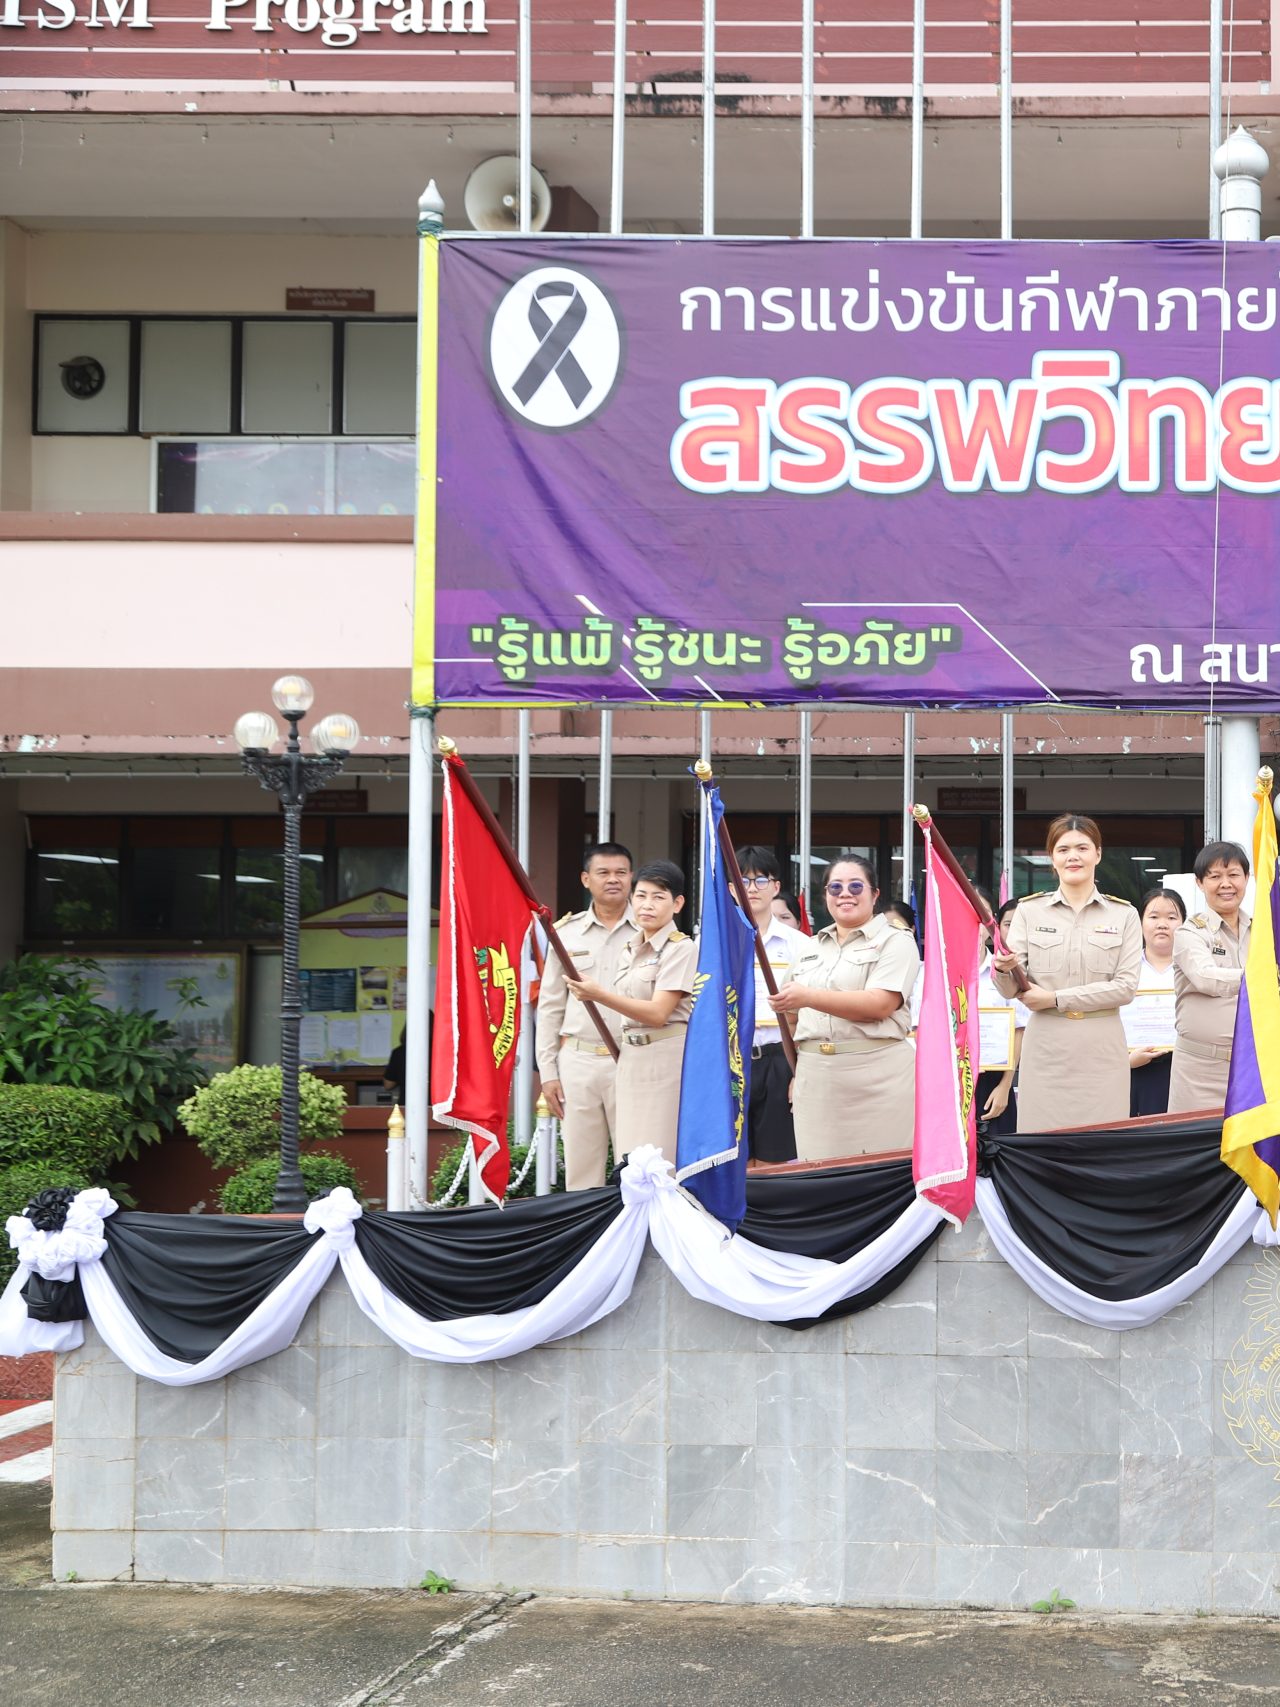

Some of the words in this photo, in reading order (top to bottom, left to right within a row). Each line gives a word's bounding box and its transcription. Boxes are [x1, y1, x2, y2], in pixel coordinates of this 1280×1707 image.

[204, 0, 489, 47] Program
[632, 616, 762, 681] รู้ชนะ
[1130, 635, 1184, 685] ณ
